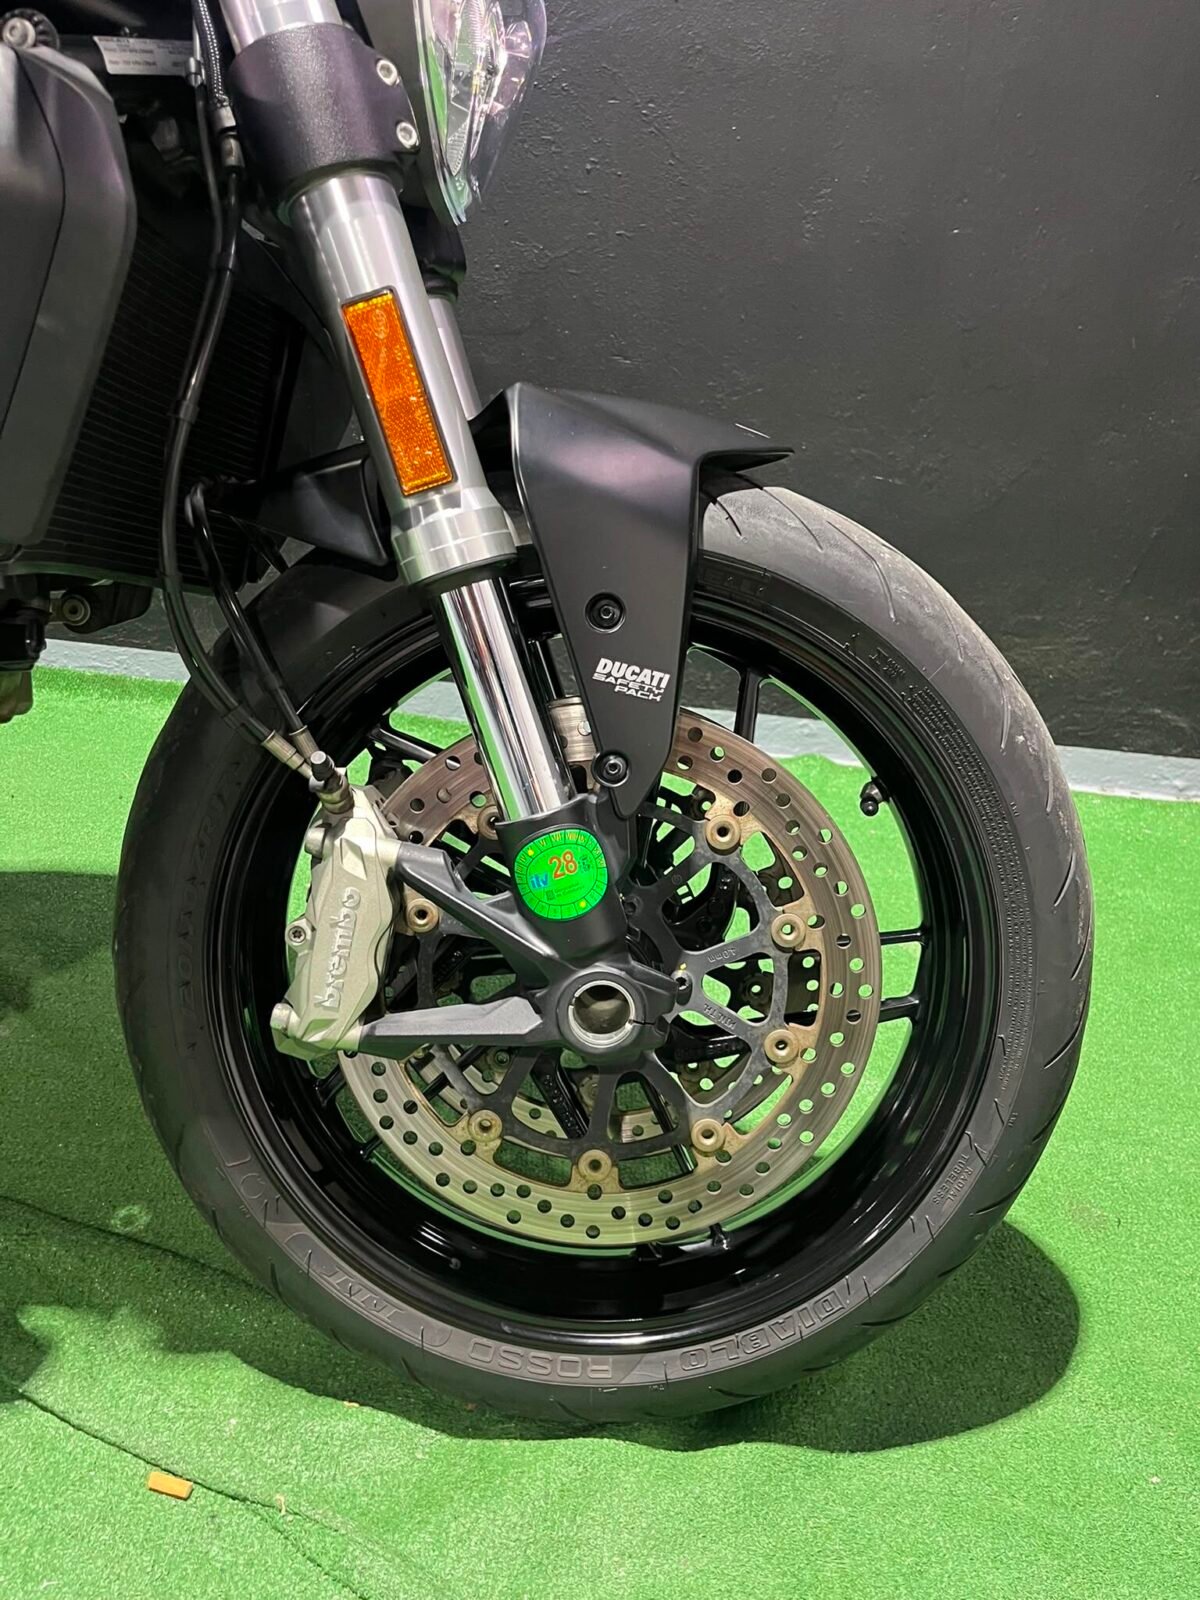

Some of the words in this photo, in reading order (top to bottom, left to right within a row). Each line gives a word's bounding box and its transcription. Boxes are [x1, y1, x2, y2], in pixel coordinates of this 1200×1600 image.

[592, 672, 665, 694] SAFETY
[595, 657, 671, 689] DUCATI
[614, 685, 662, 702] PACK
[549, 850, 577, 879] 28
[313, 886, 361, 1012] brembo
[932, 1153, 970, 1205] TUBELESS
[945, 1165, 974, 1202] RADIAL
[679, 1289, 846, 1372] DIABLO
[468, 1338, 613, 1380] ROSSO
